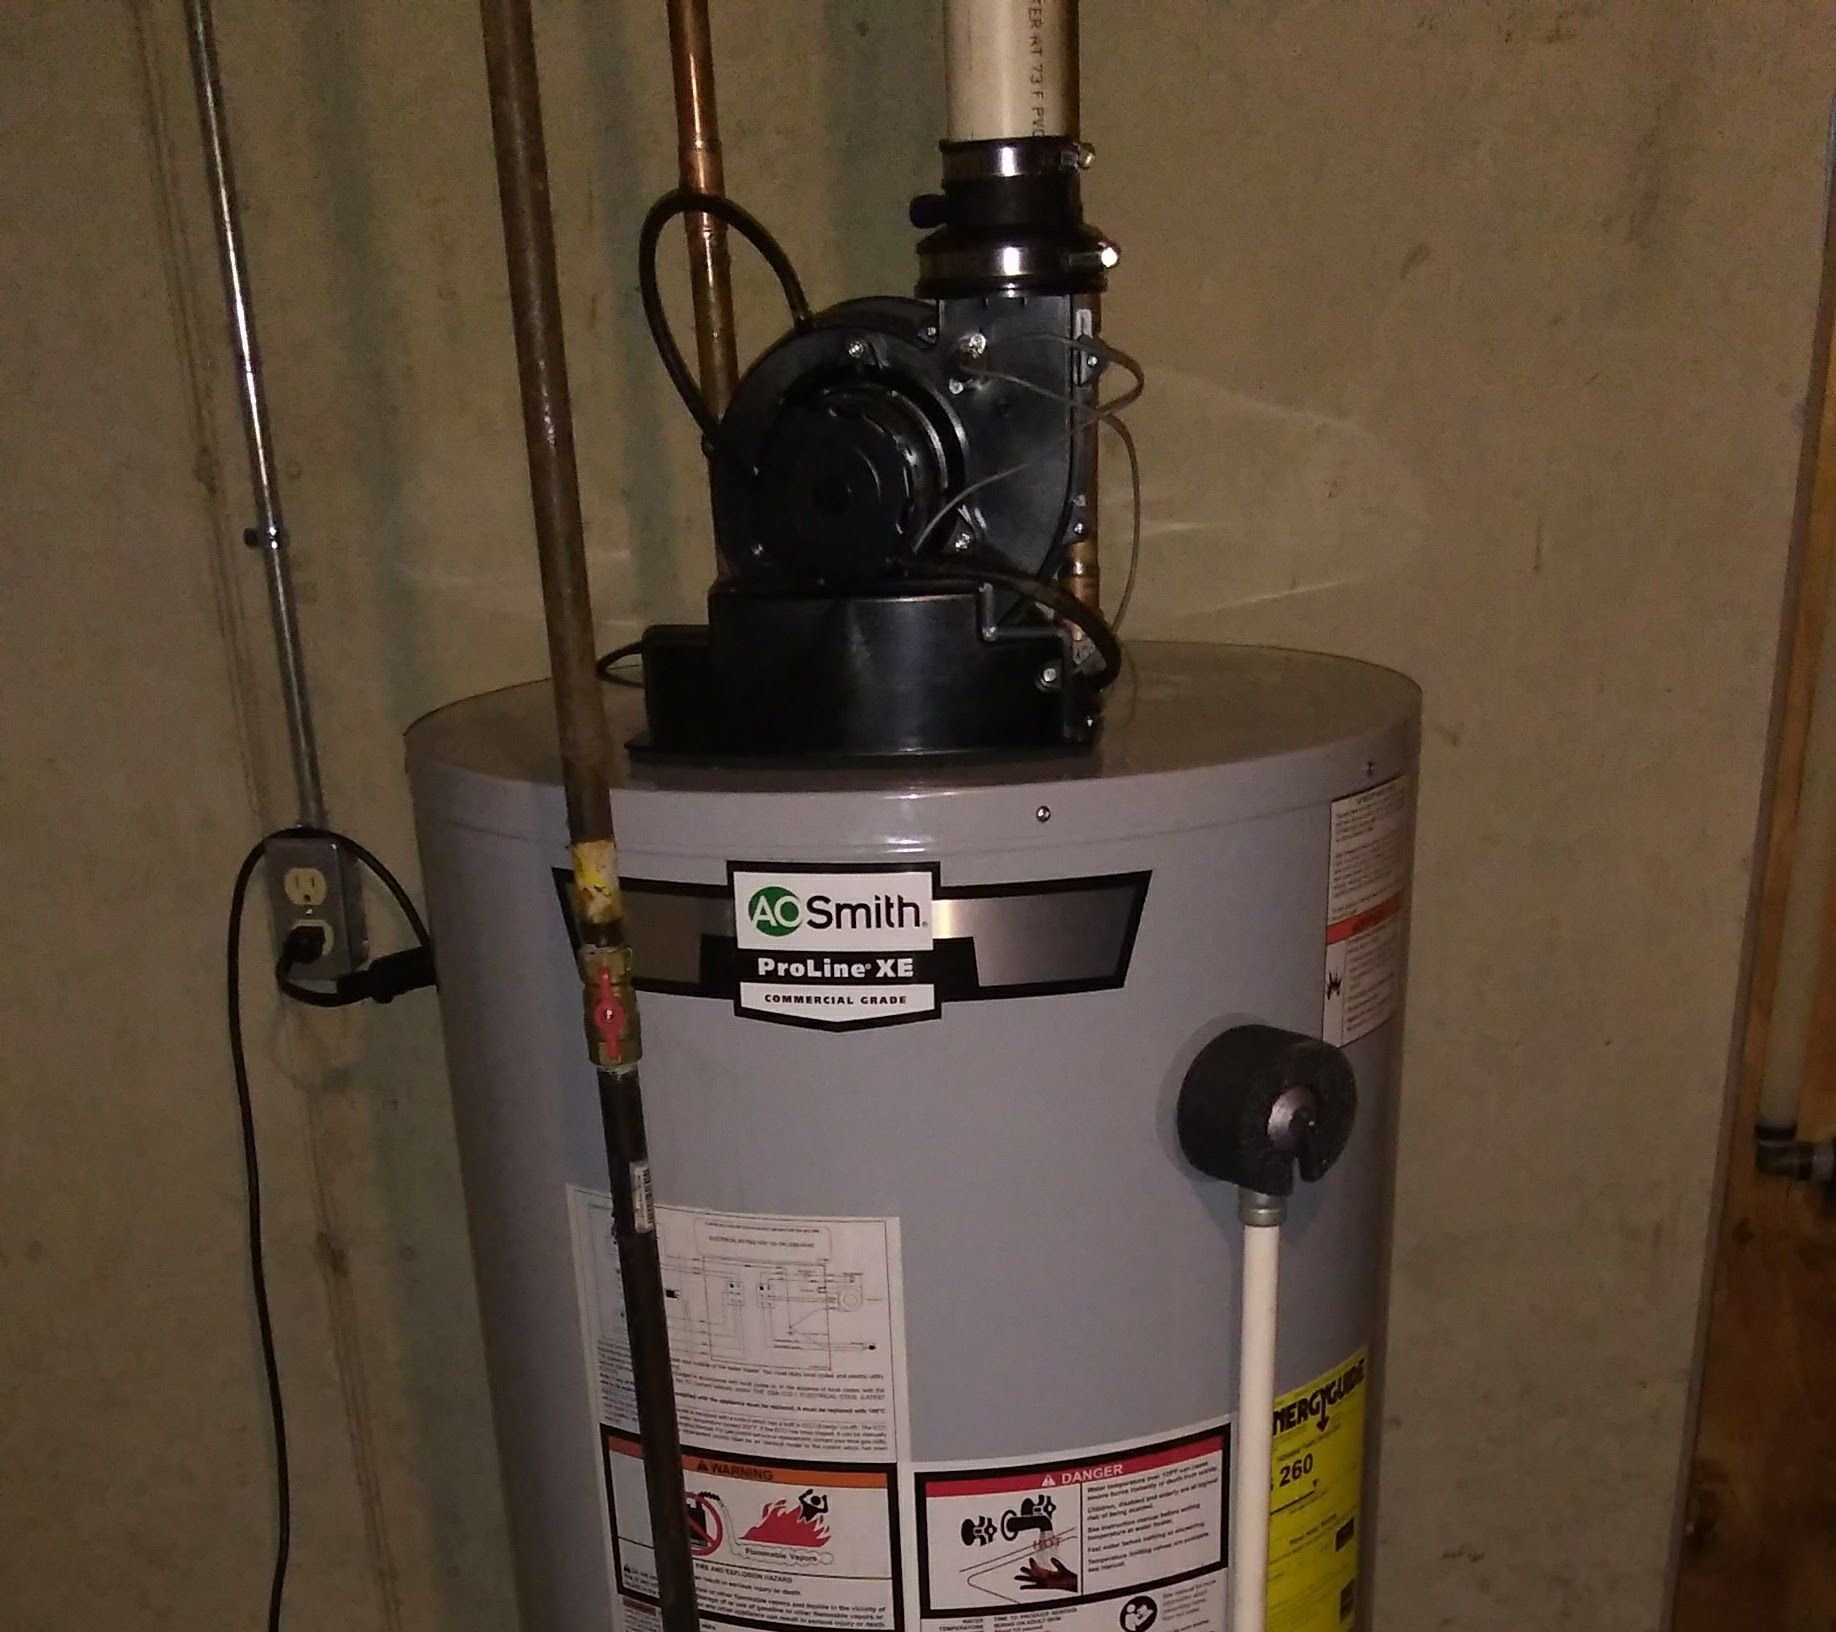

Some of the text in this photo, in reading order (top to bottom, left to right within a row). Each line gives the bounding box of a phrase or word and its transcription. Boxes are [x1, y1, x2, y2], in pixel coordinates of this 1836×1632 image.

[1030, 64, 1044, 84] 73
[1031, 91, 1044, 100] F
[1032, 107, 1045, 137] PVC
[751, 895, 921, 930] AO Smith
[875, 957, 914, 978] XE
[764, 994, 907, 1005] COMMERCIAL GRADE
[711, 1463, 773, 1481] WARNING
[1061, 1464, 1123, 1484] DANGER
[1279, 1452, 1314, 1488] 260
